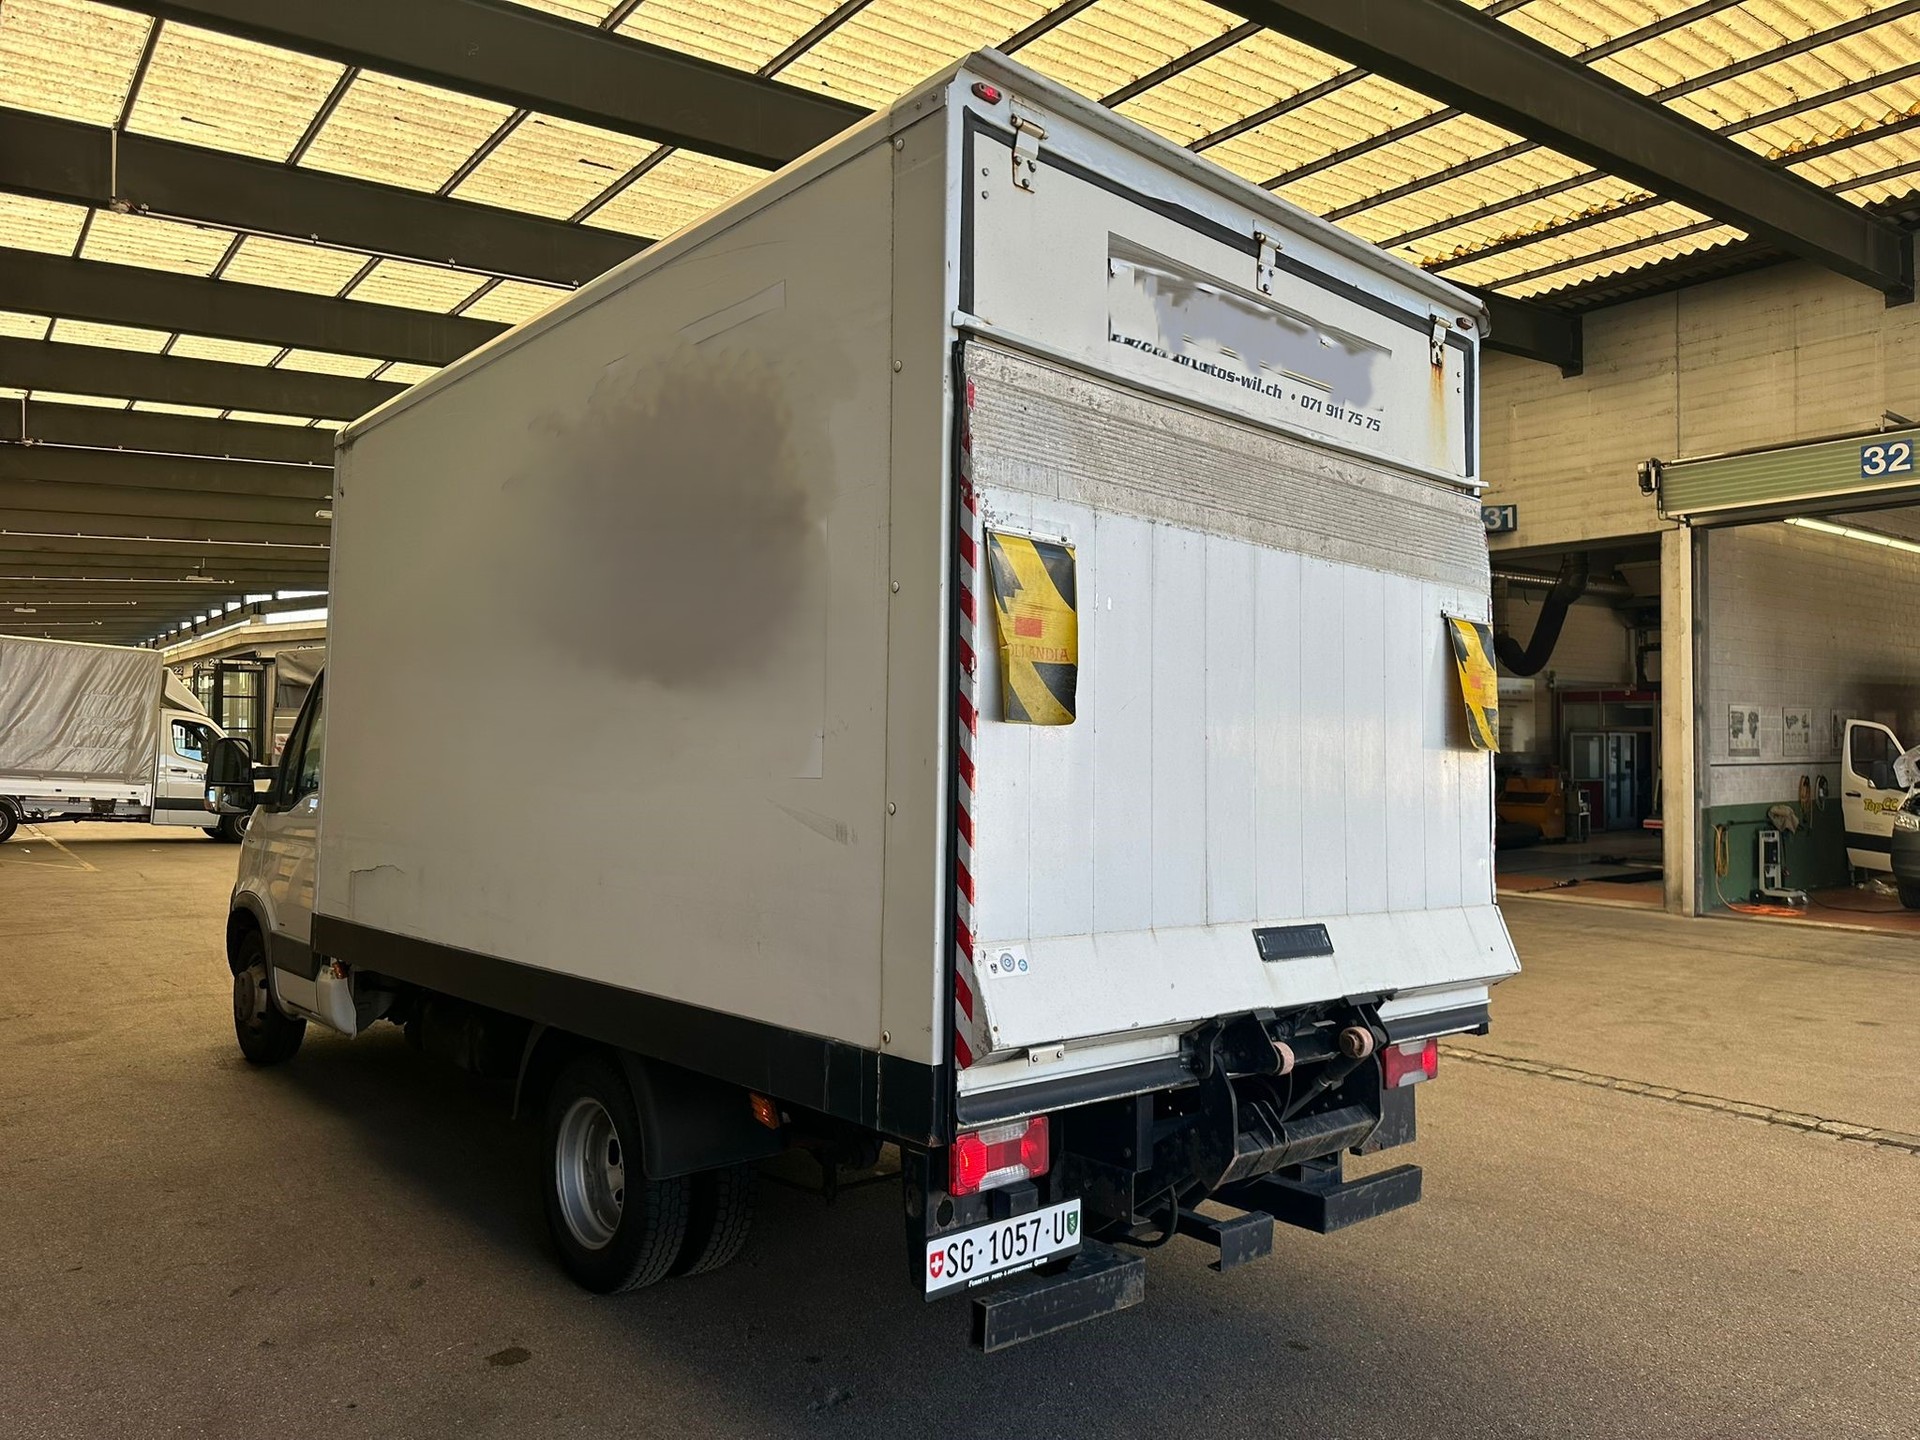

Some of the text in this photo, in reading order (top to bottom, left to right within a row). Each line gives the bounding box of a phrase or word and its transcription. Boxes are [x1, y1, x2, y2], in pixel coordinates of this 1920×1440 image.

[1300, 395, 1322, 413] 071
[1326, 404, 1344, 420] 911
[1348, 411, 1363, 426] 75
[1366, 417, 1381, 432] 75
[1863, 443, 1911, 475] 32
[1484, 506, 1513, 530] 31
